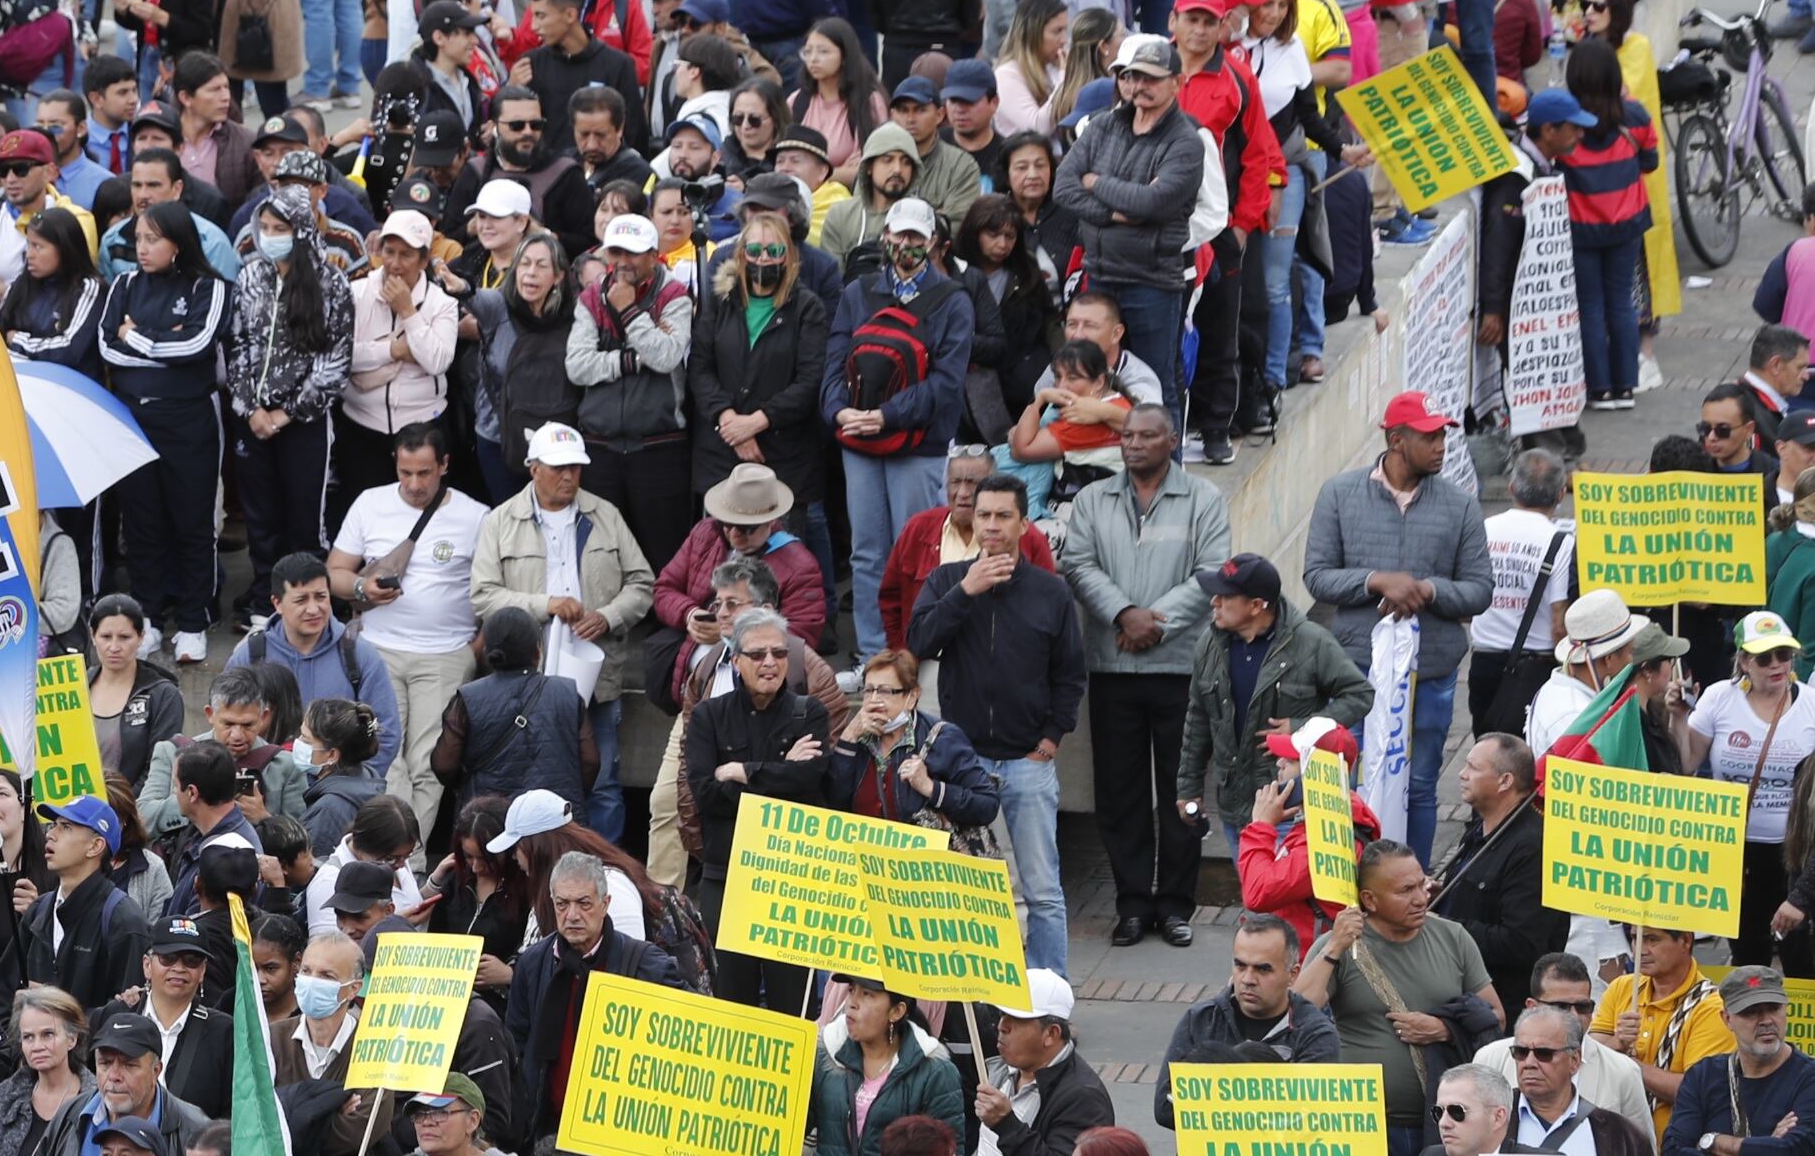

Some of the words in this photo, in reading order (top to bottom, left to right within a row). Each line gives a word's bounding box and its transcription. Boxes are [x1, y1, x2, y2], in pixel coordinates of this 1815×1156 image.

[1426, 51, 1452, 76] SOY
[1391, 84, 1416, 110] LA
[1579, 482, 1613, 502] SOY
[1618, 482, 1757, 503] SOBREVIVIENTE
[1582, 509, 1606, 525] DEL
[1610, 508, 1691, 526] GENOCIDIO
[1696, 509, 1756, 525] CONTRA
[1604, 534, 1637, 554] LA
[1645, 529, 1733, 554] UNIÓN
[1588, 557, 1754, 584] PATRIÓTICA
[1307, 789, 1321, 807] DEL
[1552, 770, 1585, 794] SOY
[1590, 777, 1741, 817] SOBREVIVIENTE
[760, 802, 785, 830] 11
[788, 807, 820, 837] De
[826, 814, 927, 849] Octubre
[1321, 819, 1338, 844] LA
[1552, 799, 1576, 820] DEL
[1580, 805, 1665, 835] GENOCIDIO
[1670, 820, 1736, 844] CONTRA
[767, 834, 791, 853] Día
[795, 840, 857, 866] Naciona
[1571, 831, 1604, 859] LA
[1613, 838, 1709, 874] UNIÓN
[740, 850, 809, 879] Dignidad
[812, 862, 830, 881] de
[834, 866, 858, 887] las
[860, 854, 886, 877] SOY
[889, 860, 1007, 893] SOBREVIVIENTE
[751, 876, 776, 894] del
[779, 881, 856, 911] Genocidio
[867, 884, 887, 903] DEL
[888, 888, 960, 910] GENOCIDIO
[963, 894, 1011, 919] CONTRA
[1552, 861, 1729, 911] PATRIÓTICA
[769, 903, 797, 924] LA
[804, 910, 872, 938] UNIÓ
[888, 914, 915, 940] LA
[920, 917, 999, 948] UNIÓN
[375, 946, 393, 967] SOY
[393, 946, 476, 971] SOBREVIVIENTE
[749, 923, 881, 966] PATRIÓTIC
[882, 943, 1021, 987] PATRIÓTICA
[381, 976, 427, 994] GENOCIDIO
[428, 977, 467, 998] CONTRA
[368, 1004, 386, 1027] LA
[388, 1001, 444, 1030] UNIÓN
[353, 1035, 445, 1067] PATRIÓTICA
[603, 1001, 642, 1040] SOY
[646, 1011, 794, 1075] SOBREVIVIENTE
[591, 1044, 621, 1083] DEL
[628, 1053, 715, 1103] GENOCIDIO
[720, 1074, 787, 1119] CONTRA
[1176, 1077, 1212, 1101] SOY
[1218, 1077, 1378, 1102] SOBREVIVIENTE
[582, 1089, 607, 1126] LA
[613, 1095, 673, 1139] UNIÓN
[677, 1114, 781, 1156] PATRIÓTICA
[1180, 1110, 1208, 1130] DEL
[1212, 1111, 1303, 1132] GENOCIDIO
[1308, 1112, 1378, 1133] CONTRA
[1206, 1141, 1242, 1156] LA
[1251, 1138, 1351, 1156] UNIÓN
